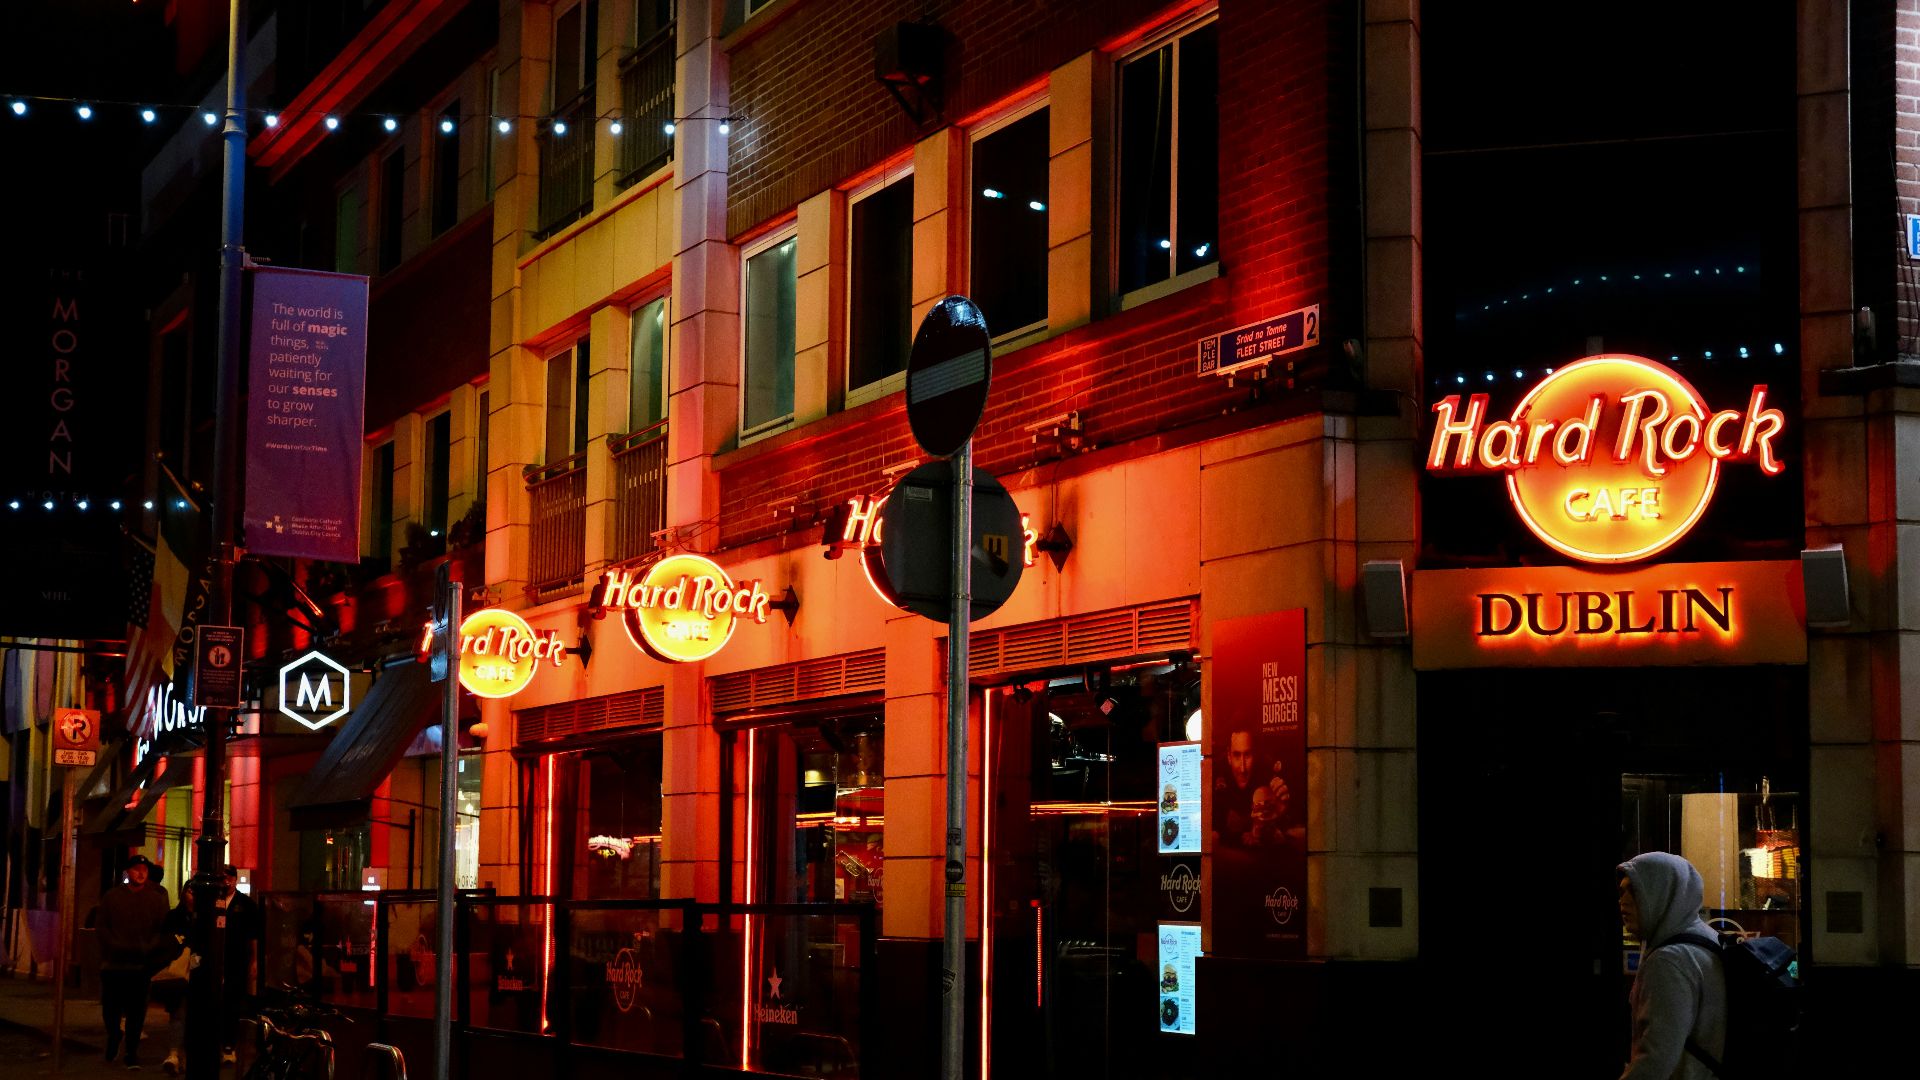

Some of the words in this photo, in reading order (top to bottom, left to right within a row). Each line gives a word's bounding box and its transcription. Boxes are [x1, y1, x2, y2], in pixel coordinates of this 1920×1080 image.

[273, 303, 294, 316] The
[297, 306, 332, 319] world
[334, 308, 344, 320] is
[271, 319, 290, 331] full
[292, 321, 306, 333] of
[308, 323, 348, 338] magic
[1306, 312, 1317, 341] 2
[270, 336, 310, 351] things,
[1203, 339, 1216, 350] TEM
[1236, 343, 1257, 359] FLEET
[1259, 335, 1286, 353] STREET
[269, 352, 322, 368] patiently
[1202, 360, 1215, 372] BAR
[1203, 350, 1216, 362] PLE
[49, 296, 79, 475] MORGAN
[268, 367, 312, 382] waiting
[315, 369, 333, 383] for
[268, 383, 289, 394] our
[292, 386, 338, 398] senses
[267, 399, 280, 409] to
[283, 401, 314, 413] grow
[267, 414, 317, 429] sharper.
[1427, 392, 1607, 470] Hard
[1612, 384, 1785, 480] Rock
[1563, 487, 1661, 522] CAFE
[603, 568, 688, 611] Hard
[690, 575, 770, 624] Rock
[1477, 588, 1734, 636] DUBLIN
[499, 626, 567, 667] Rock
[1262, 661, 1279, 679] NEW
[296, 673, 332, 712] M
[1262, 675, 1298, 704] MESSI
[1262, 701, 1298, 725] BURGER
[1160, 874, 1182, 891] Hard
[1182, 874, 1202, 895] Rock
[1265, 894, 1282, 909] Hard
[1282, 894, 1299, 911] Rock
[605, 960, 625, 983] Hard
[624, 961, 643, 989] Rock
[754, 1003, 798, 1026] Heineken
